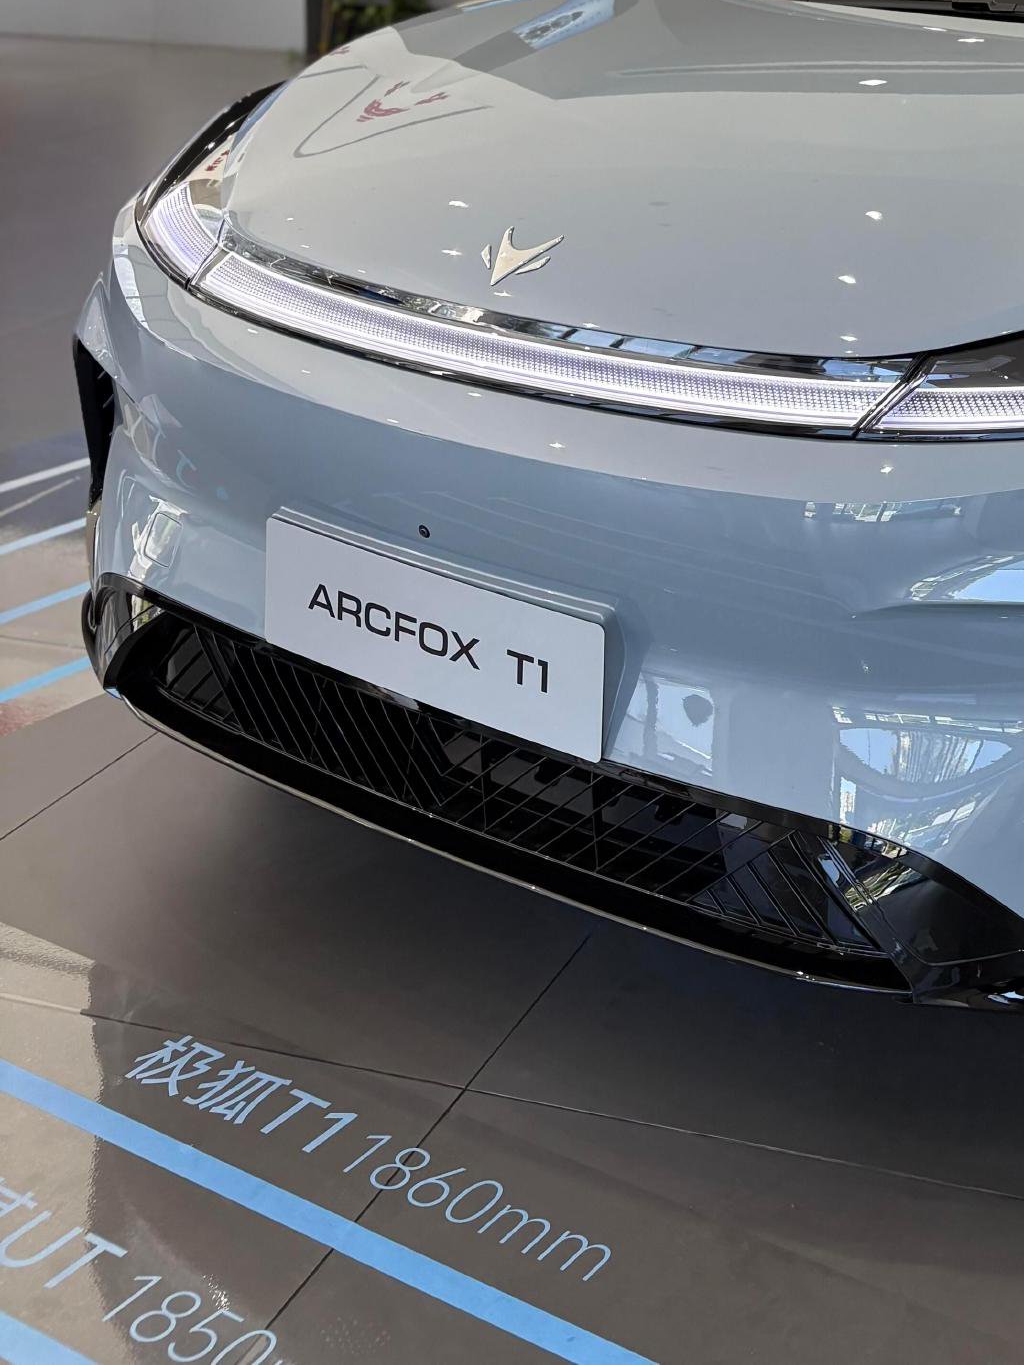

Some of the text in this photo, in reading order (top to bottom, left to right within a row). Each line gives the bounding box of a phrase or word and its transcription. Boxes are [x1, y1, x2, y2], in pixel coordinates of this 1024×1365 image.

[307, 583, 549, 694] ARCFOX T1
[343, 1134, 612, 1282] 1860mm
[102, 1275, 284, 1365] 1850
